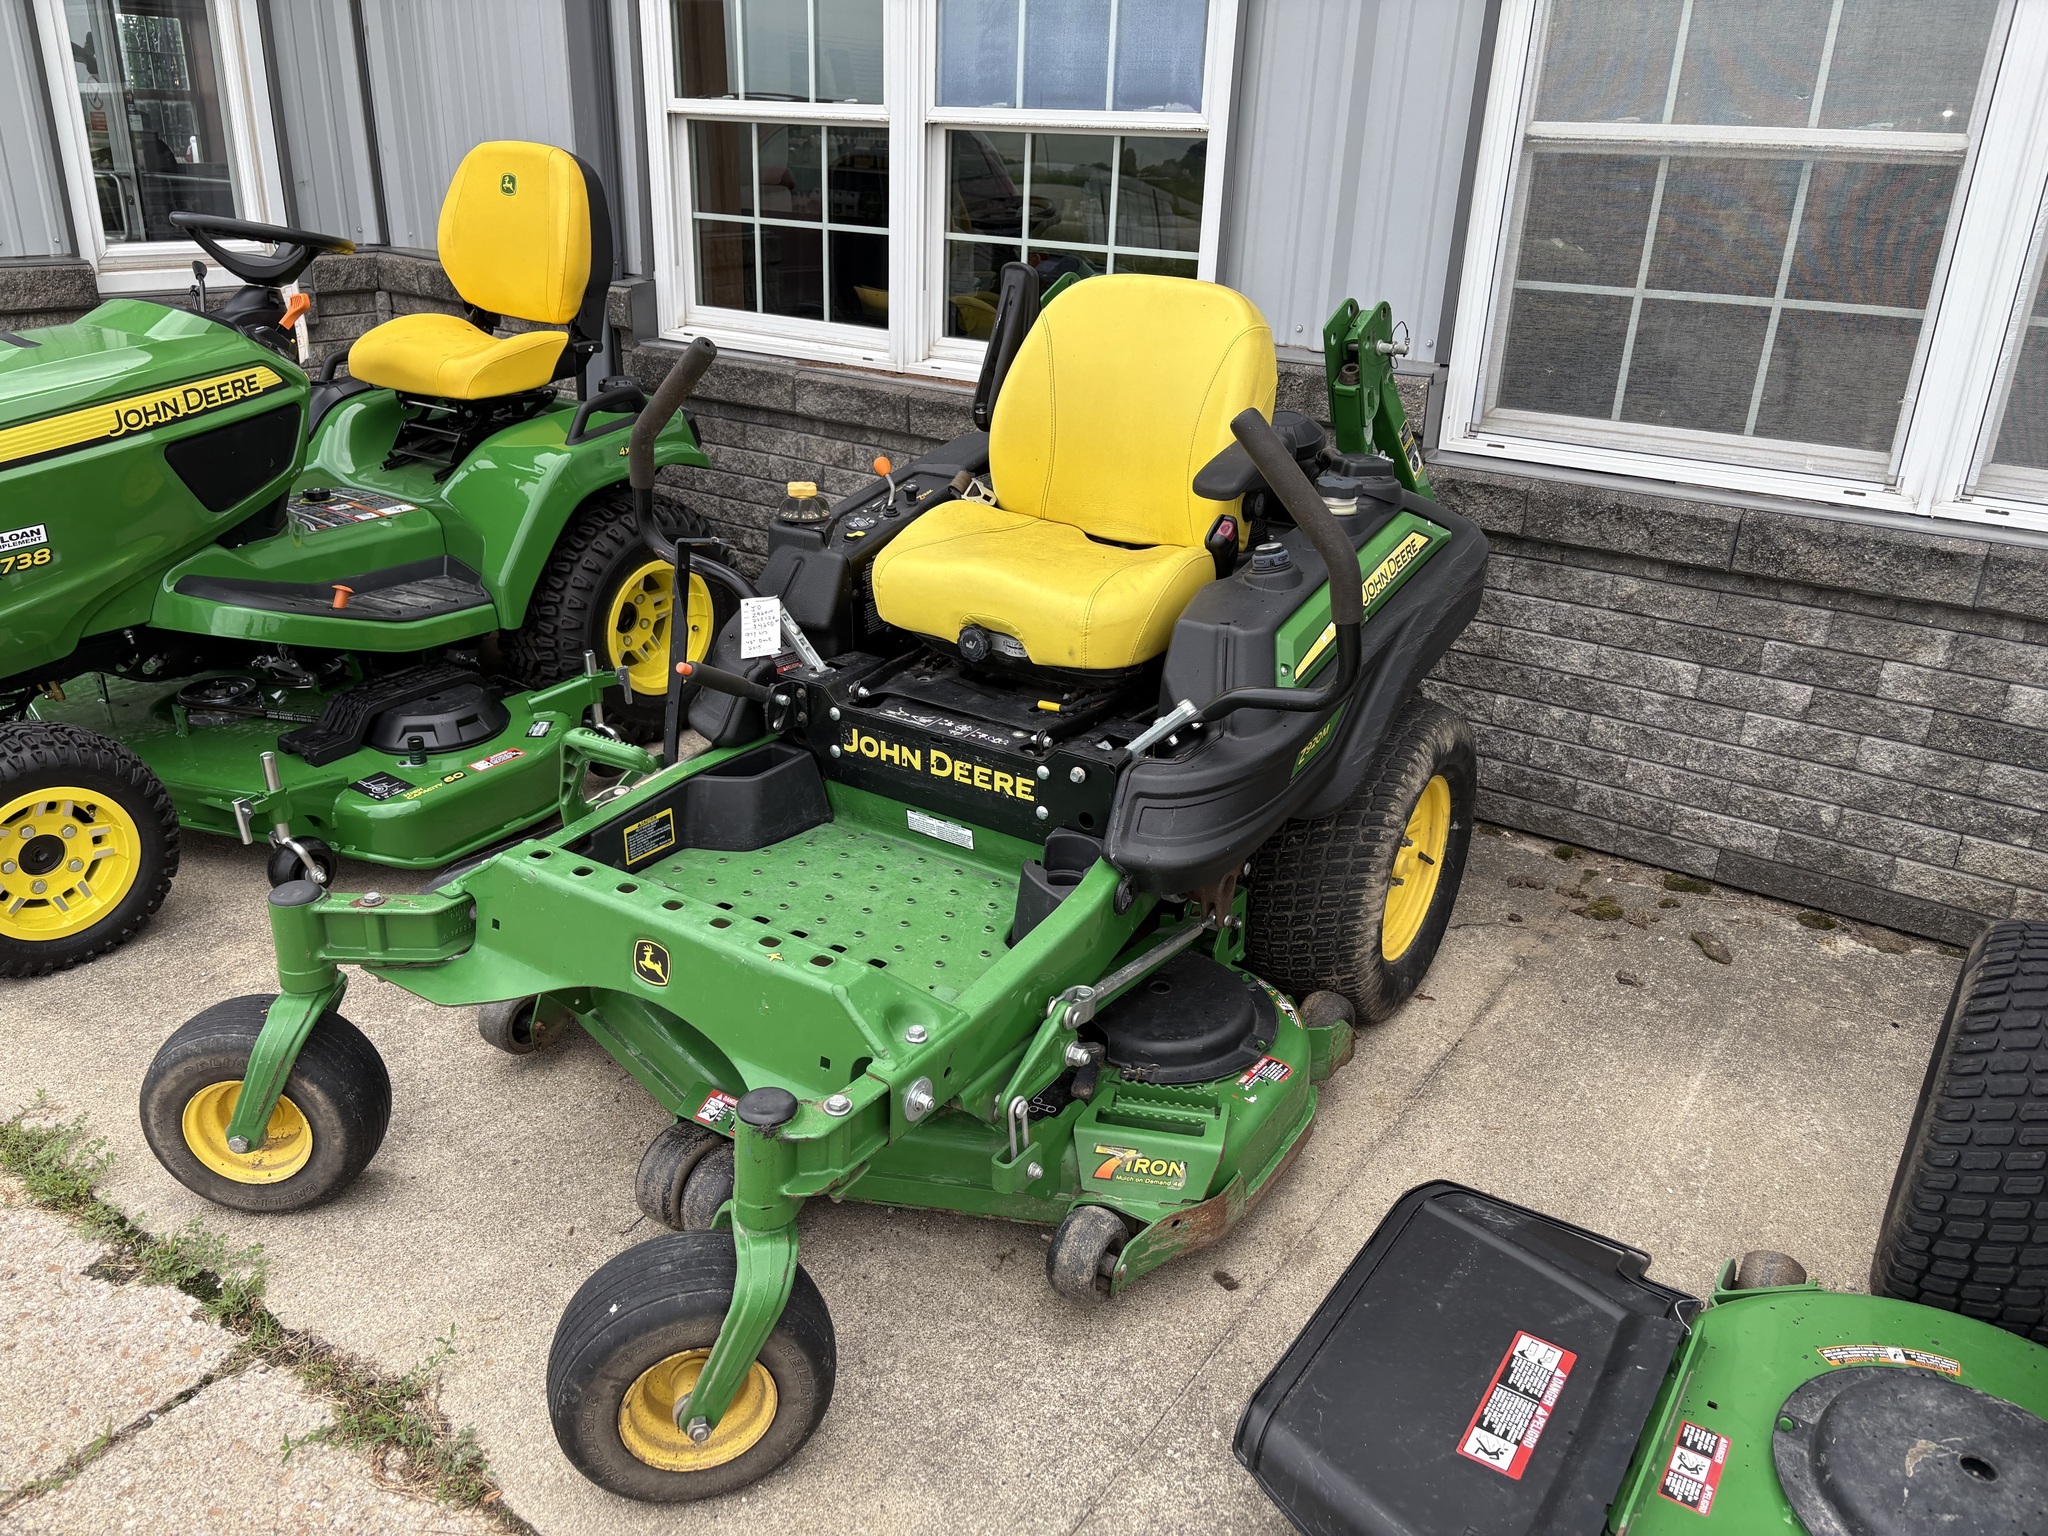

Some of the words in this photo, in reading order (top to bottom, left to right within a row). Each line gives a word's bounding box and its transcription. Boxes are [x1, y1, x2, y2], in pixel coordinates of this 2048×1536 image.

[109, 397, 181, 435] JOHN
[182, 373, 262, 412] DEERE
[1363, 567, 1389, 605] JOHN
[1387, 538, 1419, 576] DEERE
[843, 728, 922, 772] JOHN
[930, 748, 1035, 802] DEERE
[1297, 723, 1331, 766] Z920M
[443, 771, 464, 783] 60
[1542, 1375, 1565, 1407] DANGER
[1522, 1412, 1547, 1449] PELIGRO
